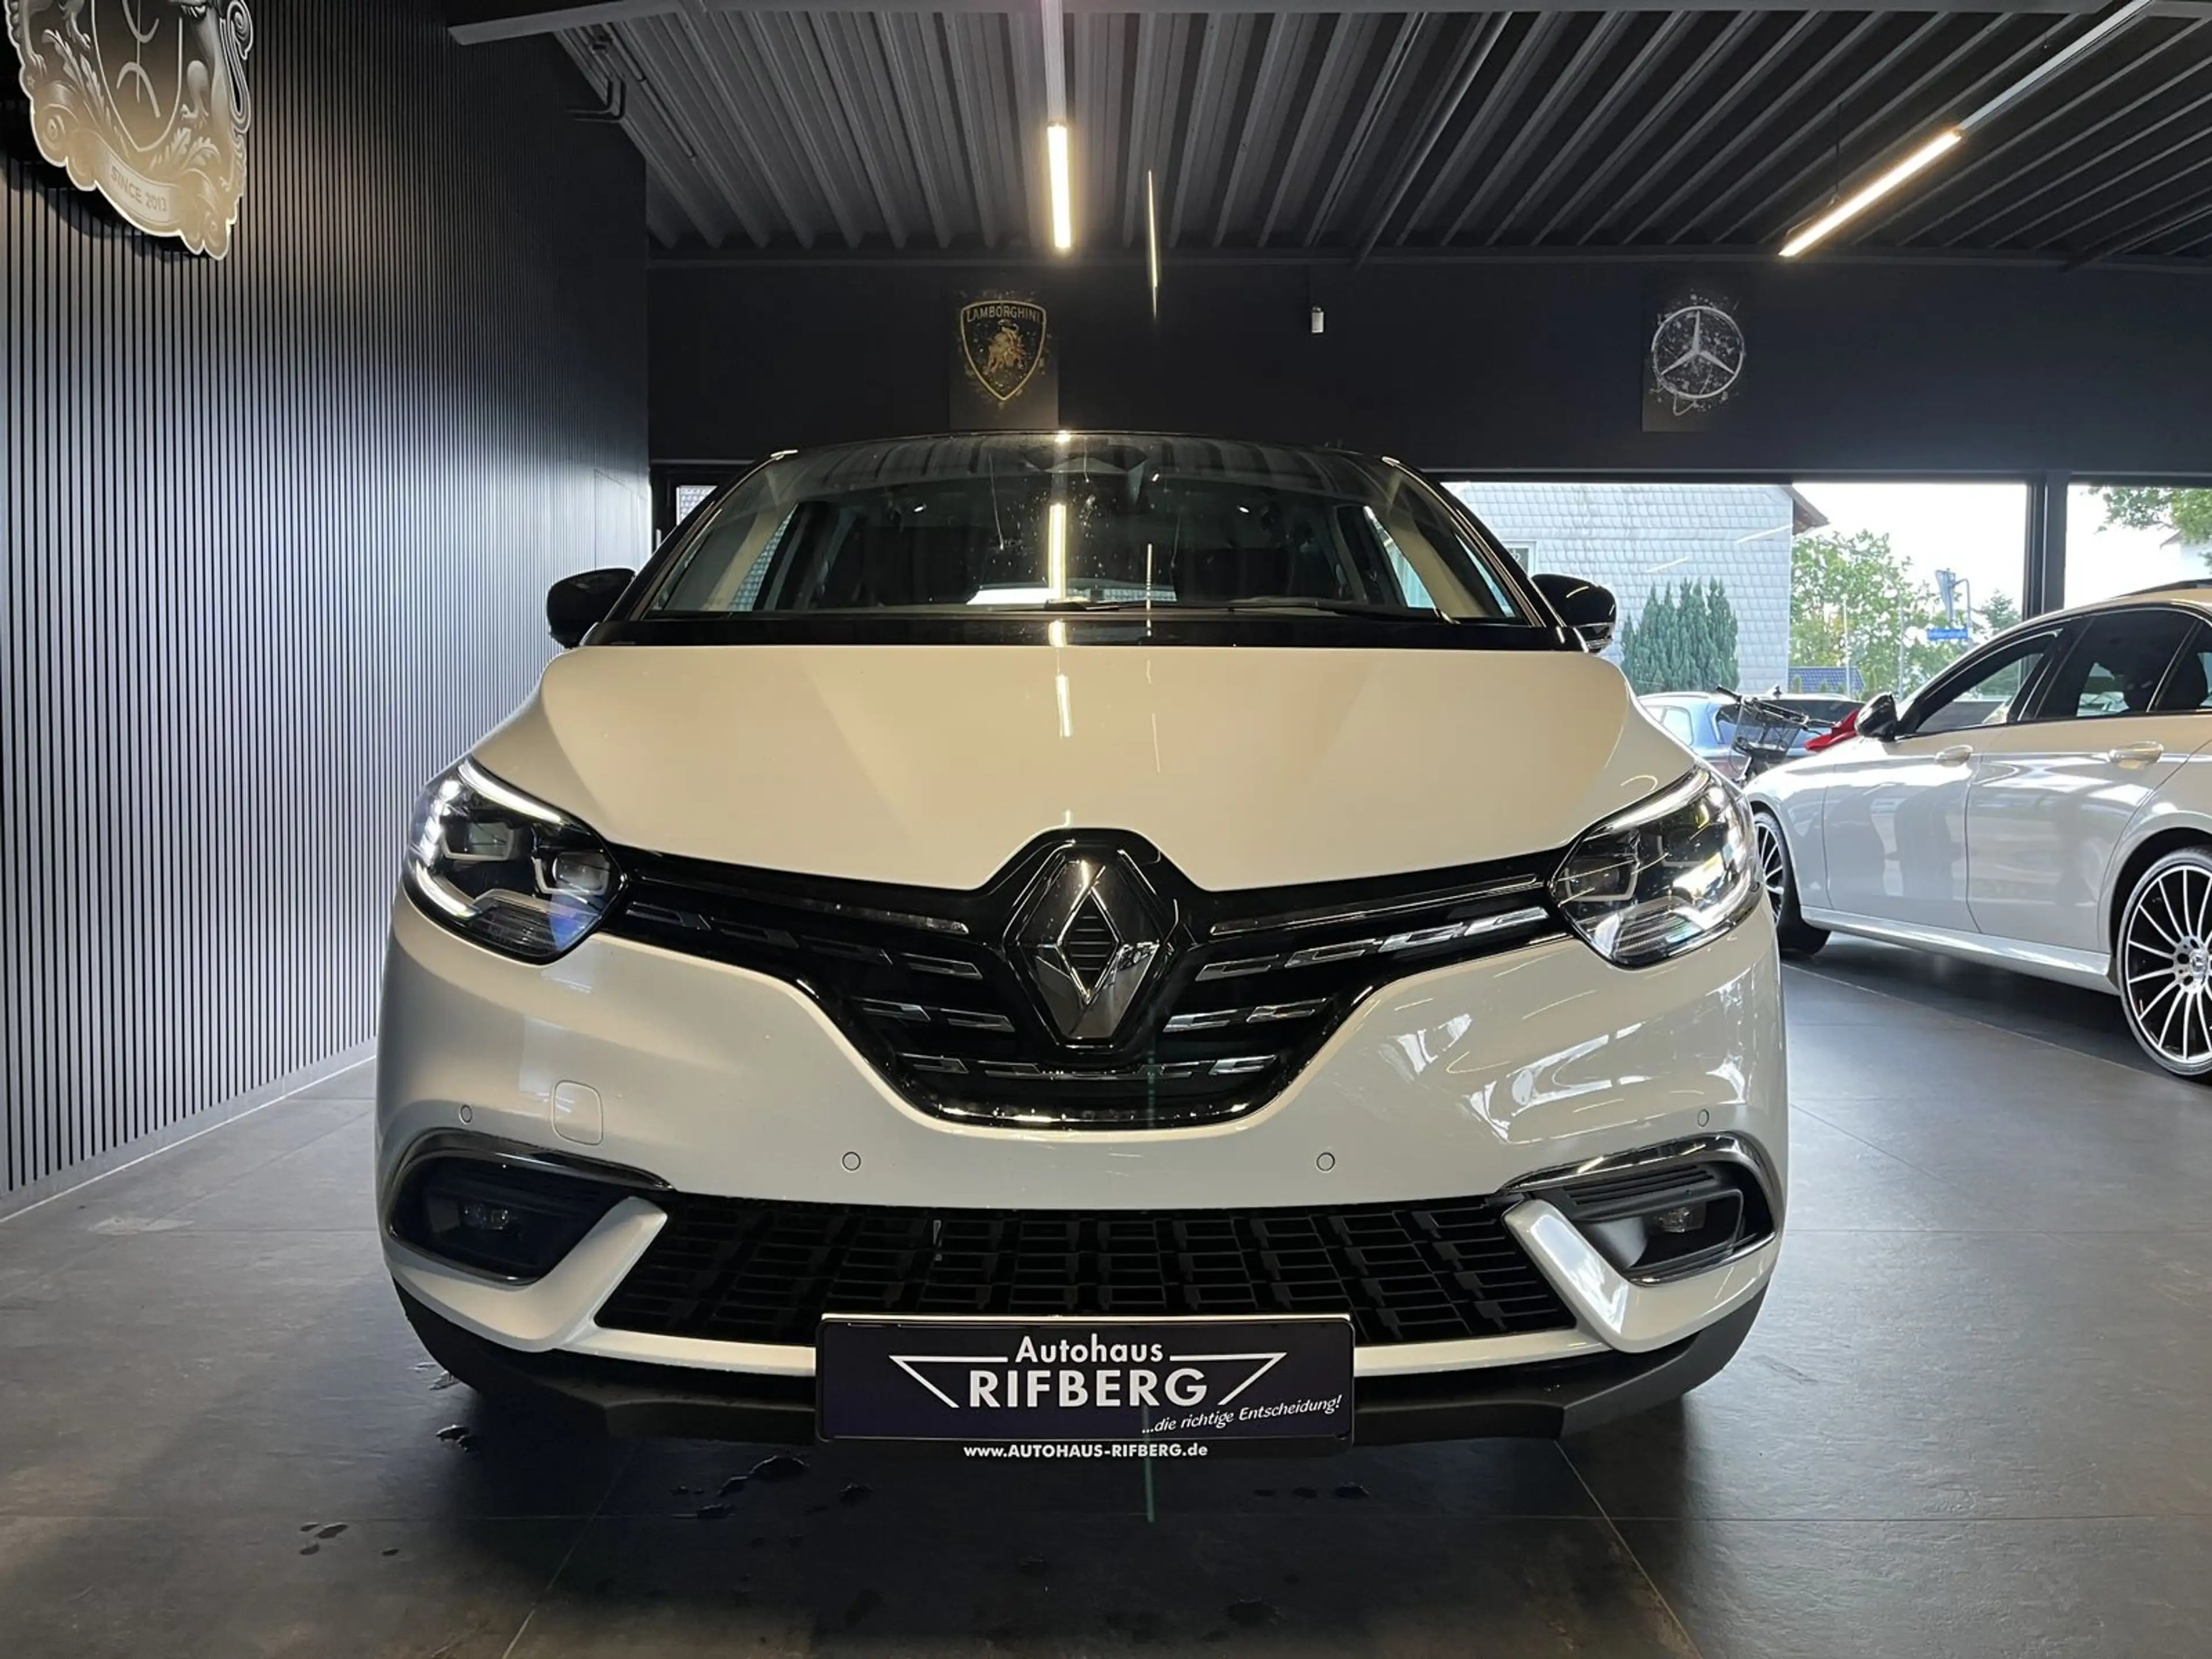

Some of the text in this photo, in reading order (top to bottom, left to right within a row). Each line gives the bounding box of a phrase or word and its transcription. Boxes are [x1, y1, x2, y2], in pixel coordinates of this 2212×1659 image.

[111, 165, 142, 204] SINCE
[965, 305, 1040, 323] LAMBORGHINI
[1014, 1332, 1164, 1363] Autohaus
[969, 1368, 1208, 1408] RIFBERG
[1142, 1394, 1343, 1434] ...die richtige Entscheidung!
[963, 1442, 1209, 1458] www.AUTOHAUS-RIFBERG.de
